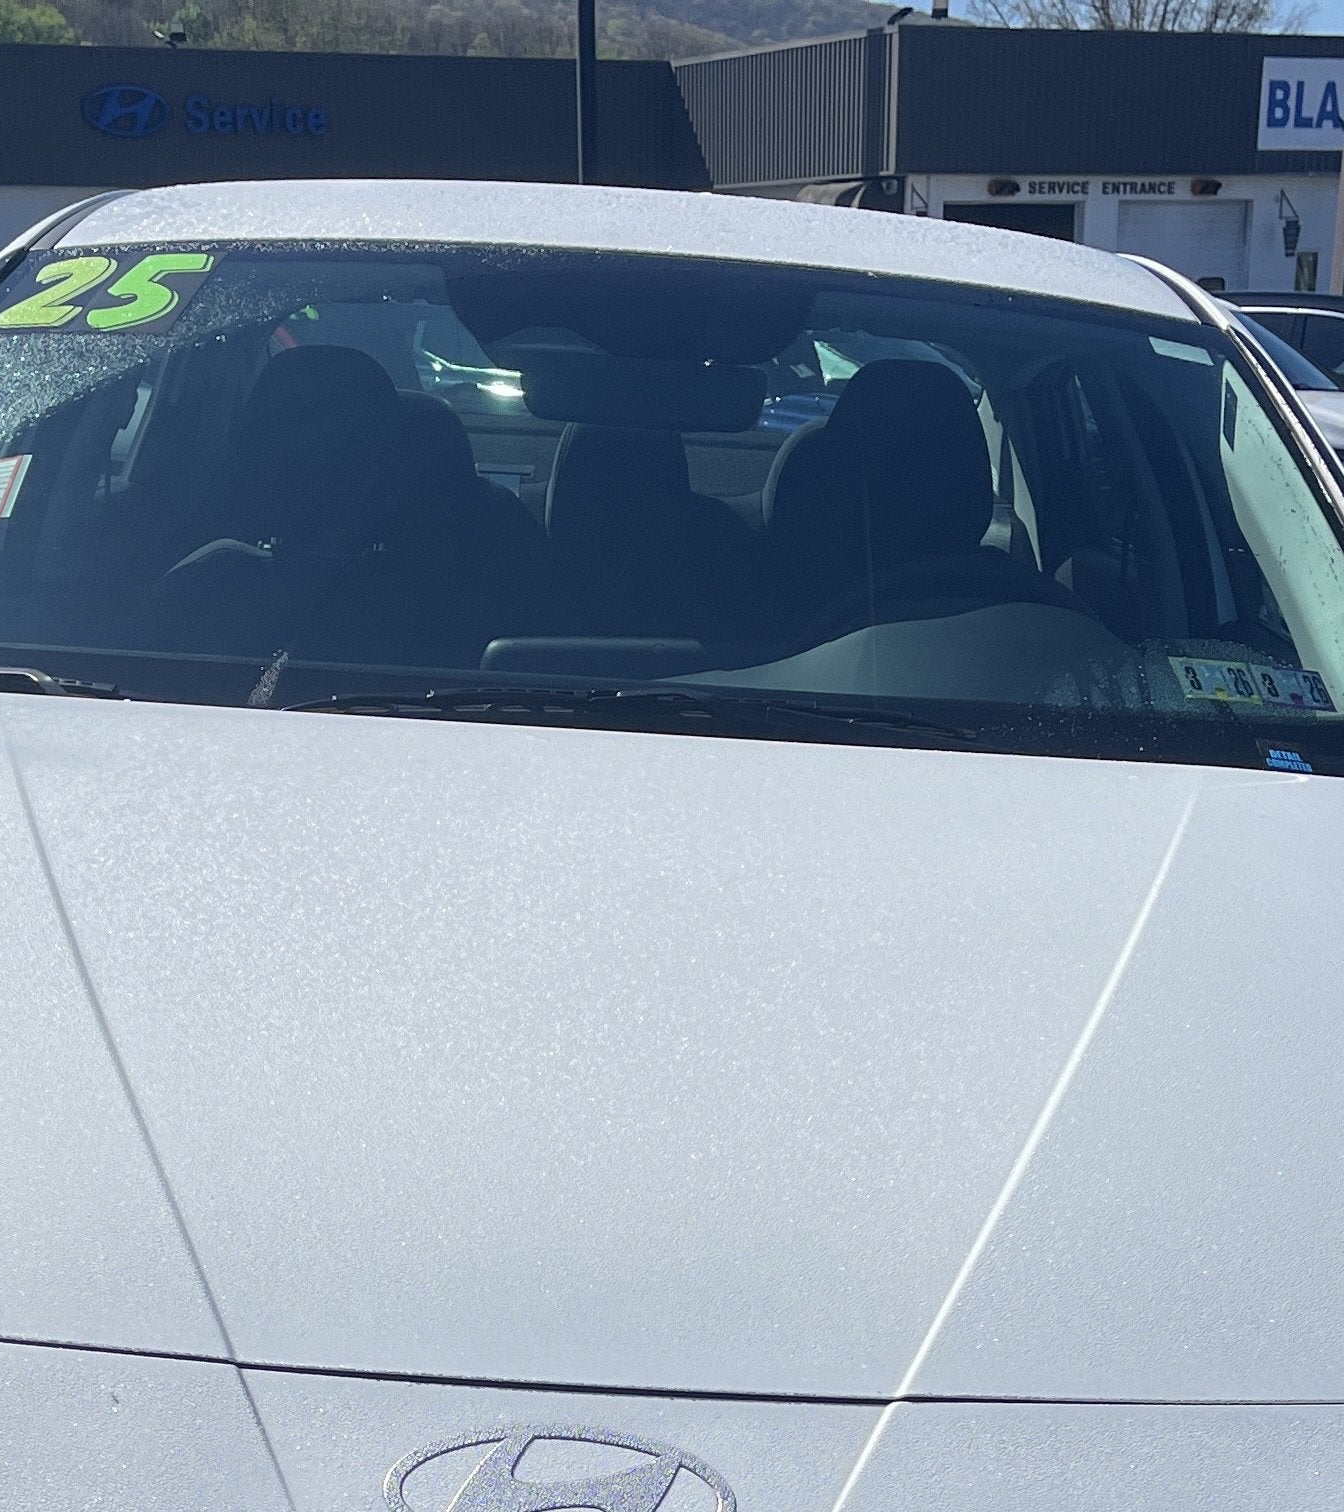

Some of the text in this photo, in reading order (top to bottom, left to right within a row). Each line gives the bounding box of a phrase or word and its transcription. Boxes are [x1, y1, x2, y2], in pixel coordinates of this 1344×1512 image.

[185, 93, 329, 136] Service
[1028, 180, 1177, 195] SERVICE ENTRANCE
[1183, 666, 1254, 698] 3 26
[1260, 672, 1330, 705] 3 26
